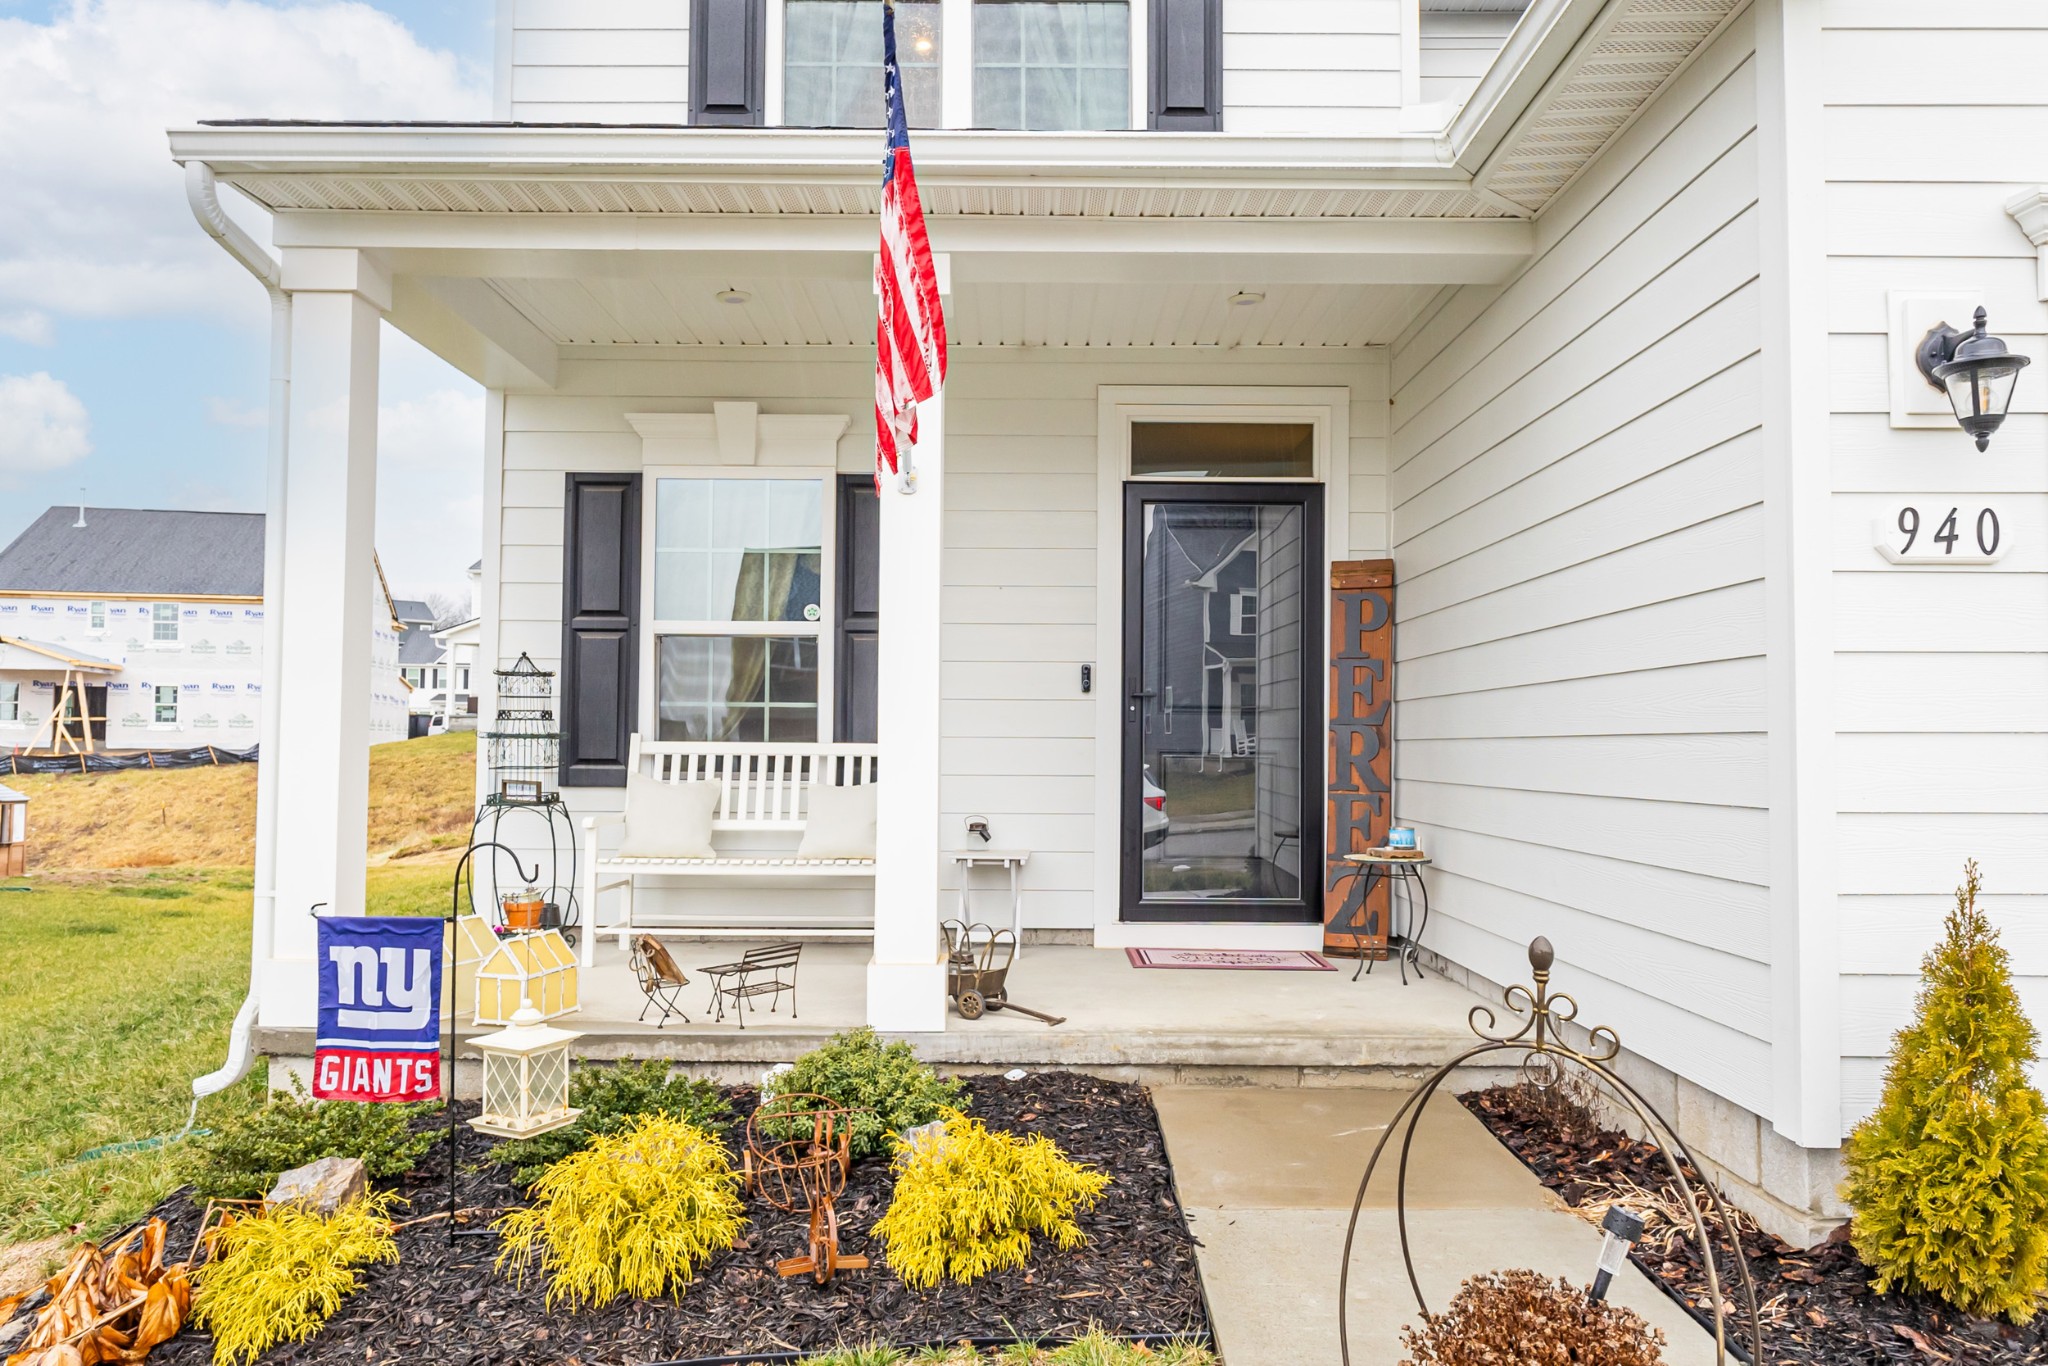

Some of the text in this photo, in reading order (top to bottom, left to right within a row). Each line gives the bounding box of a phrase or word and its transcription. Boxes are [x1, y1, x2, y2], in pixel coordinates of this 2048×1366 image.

[1898, 506, 2000, 556] 940
[0, 604, 18, 613] yan
[31, 604, 55, 613] Ryan
[139, 607, 150, 616] Ry
[209, 608, 233, 617] Ryan
[33, 679, 57, 689] Ryan
[105, 681, 129, 690] Ryan
[141, 681, 152, 690] Ry
[183, 683, 200, 691] yan
[212, 682, 235, 692] Ryan
[1326, 592, 1391, 936] PEREZ
[328, 945, 432, 1031] ny
[318, 1055, 433, 1095] GIANTS
